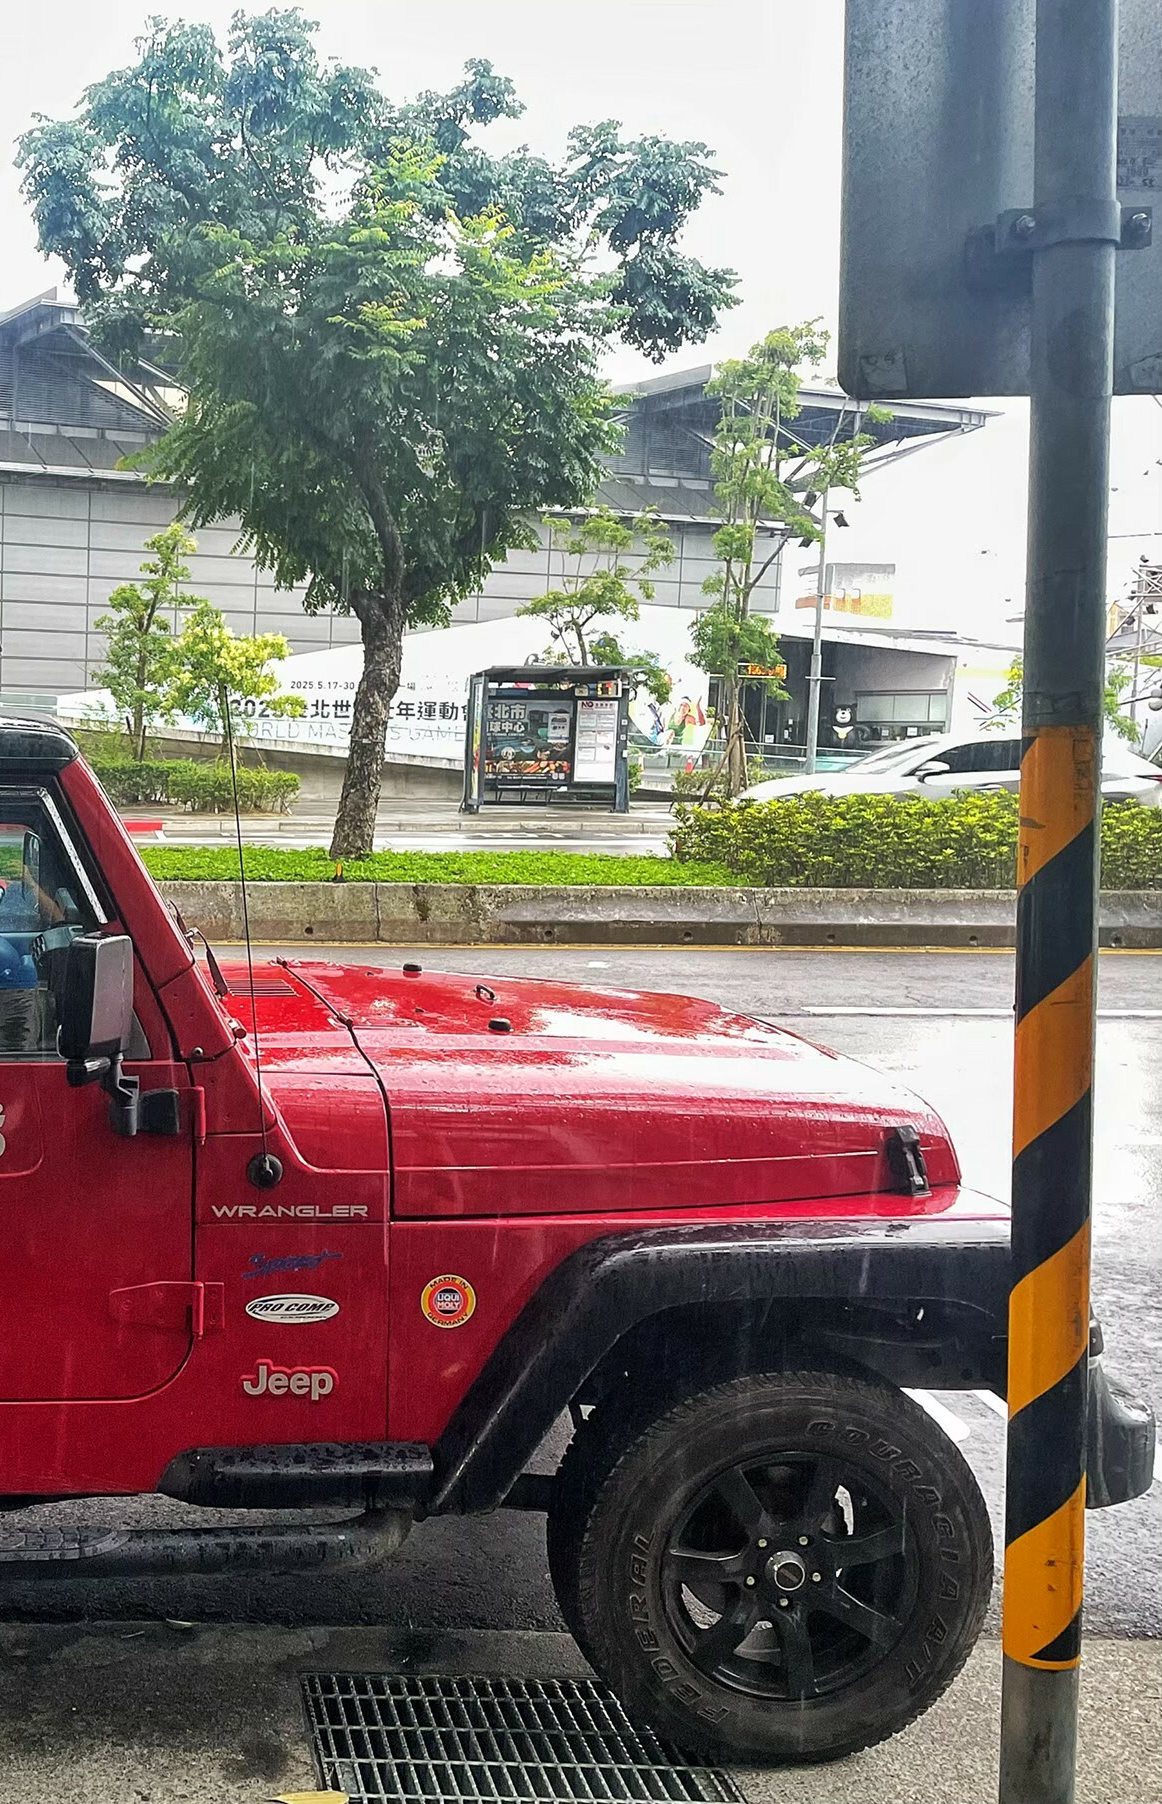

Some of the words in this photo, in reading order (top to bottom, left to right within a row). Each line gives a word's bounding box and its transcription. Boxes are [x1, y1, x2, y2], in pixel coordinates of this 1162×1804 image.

[290, 680, 355, 690] 2025.5.17-30
[486, 721, 525, 732] 球中心
[211, 1205, 368, 1218] WRANGLER
[429, 1276, 457, 1289] MADE
[459, 1280, 469, 1290] IN
[248, 1303, 284, 1312] PRO
[284, 1303, 335, 1312] COMP
[437, 1301, 460, 1309] MOLY
[427, 1312, 469, 1326] GERMANY
[242, 1363, 335, 1400] Jeep
[806, 1420, 960, 1601] COURAGIA
[630, 1528, 731, 1724] FEDERAL
